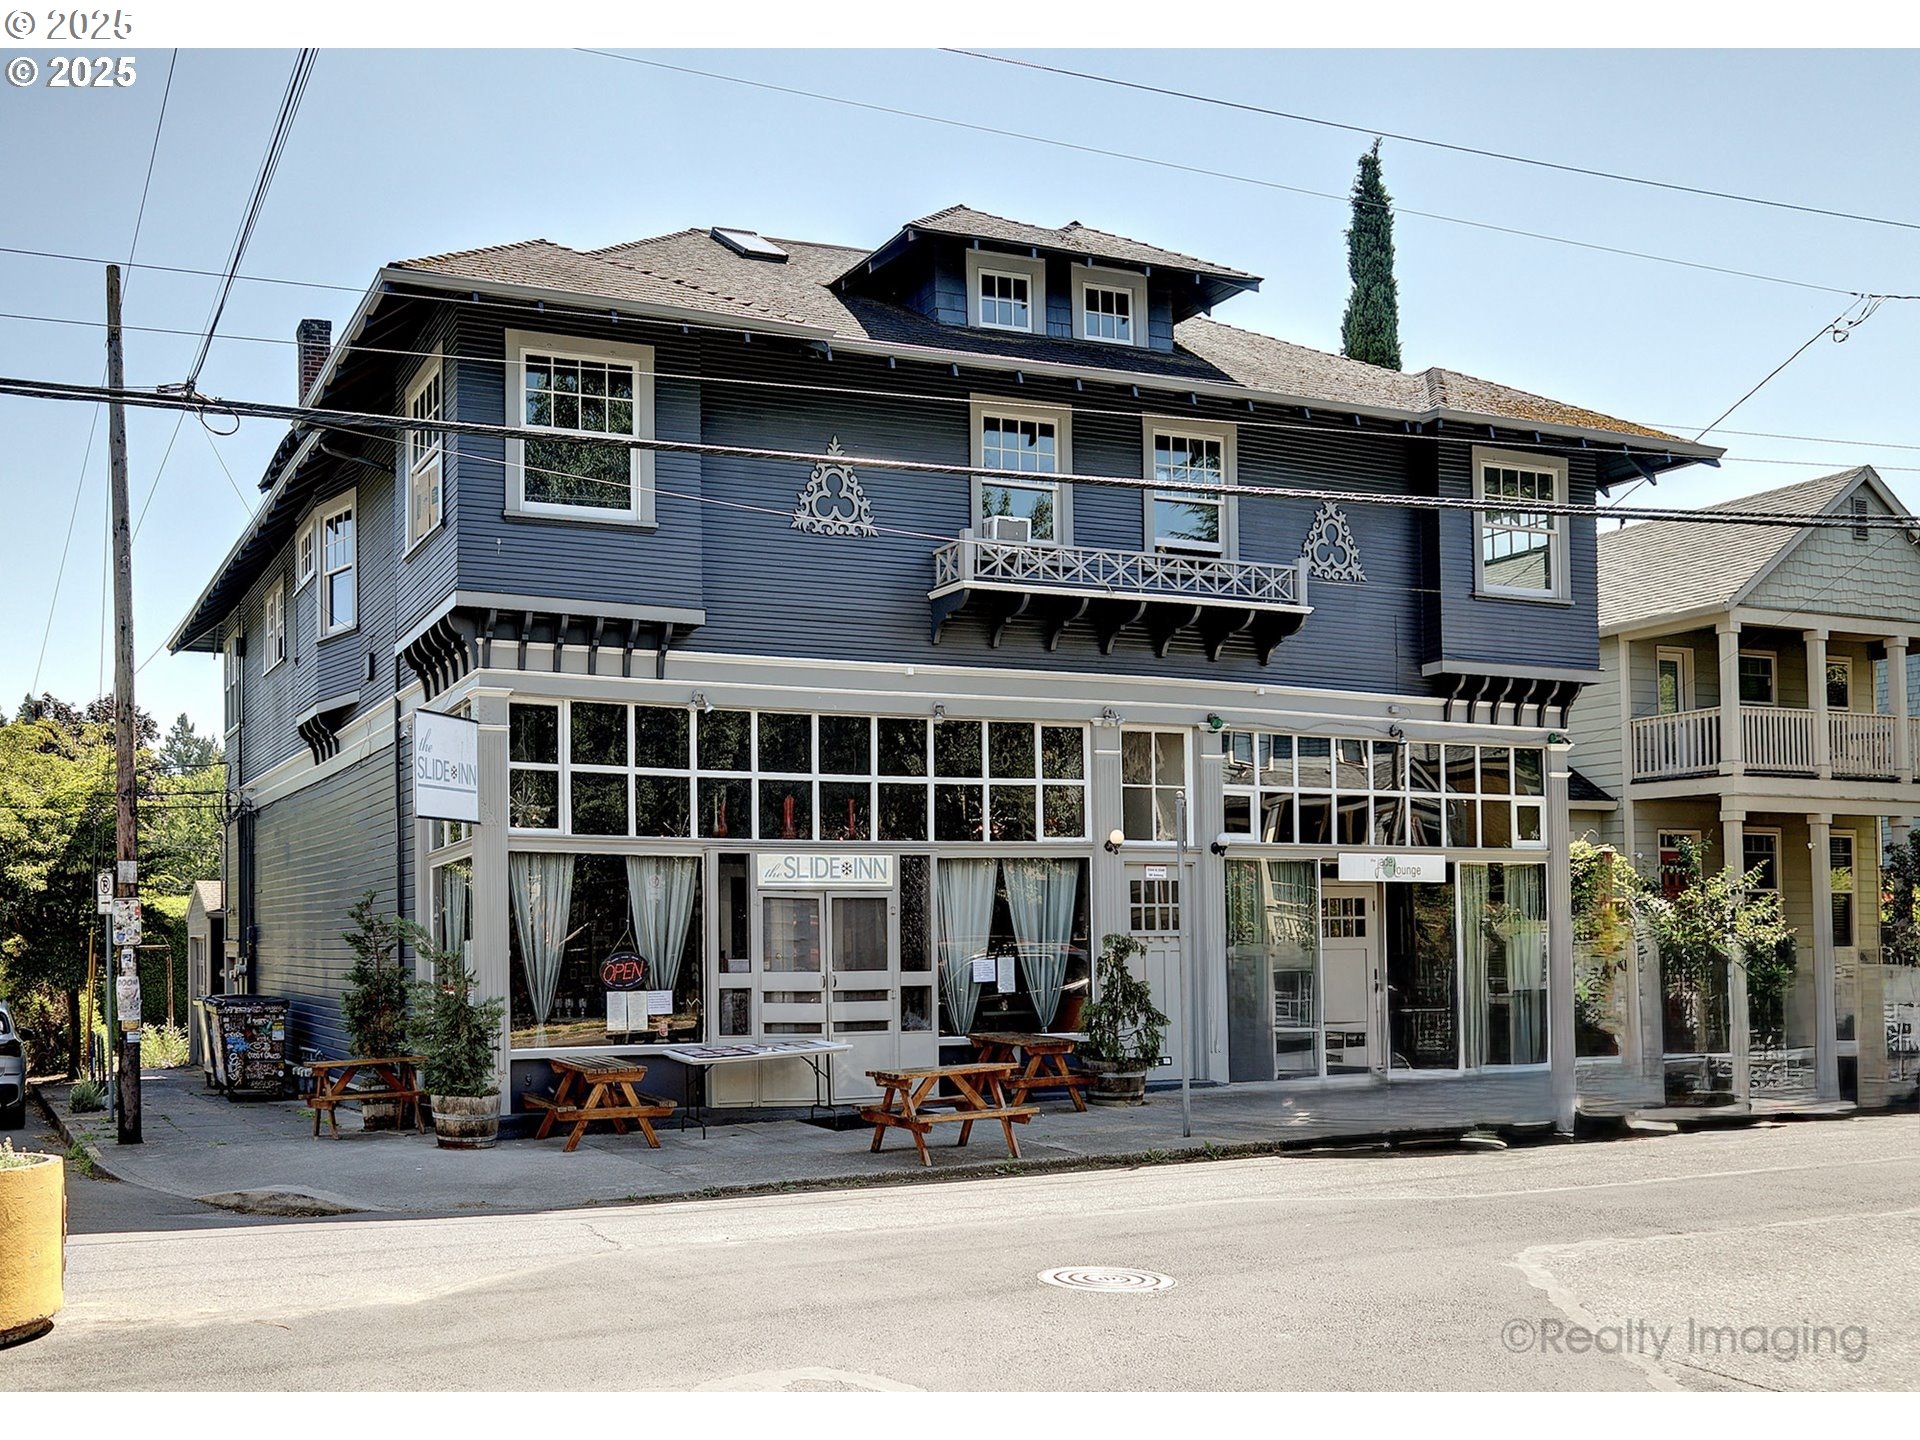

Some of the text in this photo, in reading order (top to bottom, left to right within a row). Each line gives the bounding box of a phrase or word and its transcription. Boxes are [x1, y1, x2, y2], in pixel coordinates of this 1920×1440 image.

[418, 728, 432, 753] the
[417, 756, 477, 787] SLIDE INN
[764, 856, 888, 880] the SLIDE INN
[603, 961, 644, 981] OPEN
